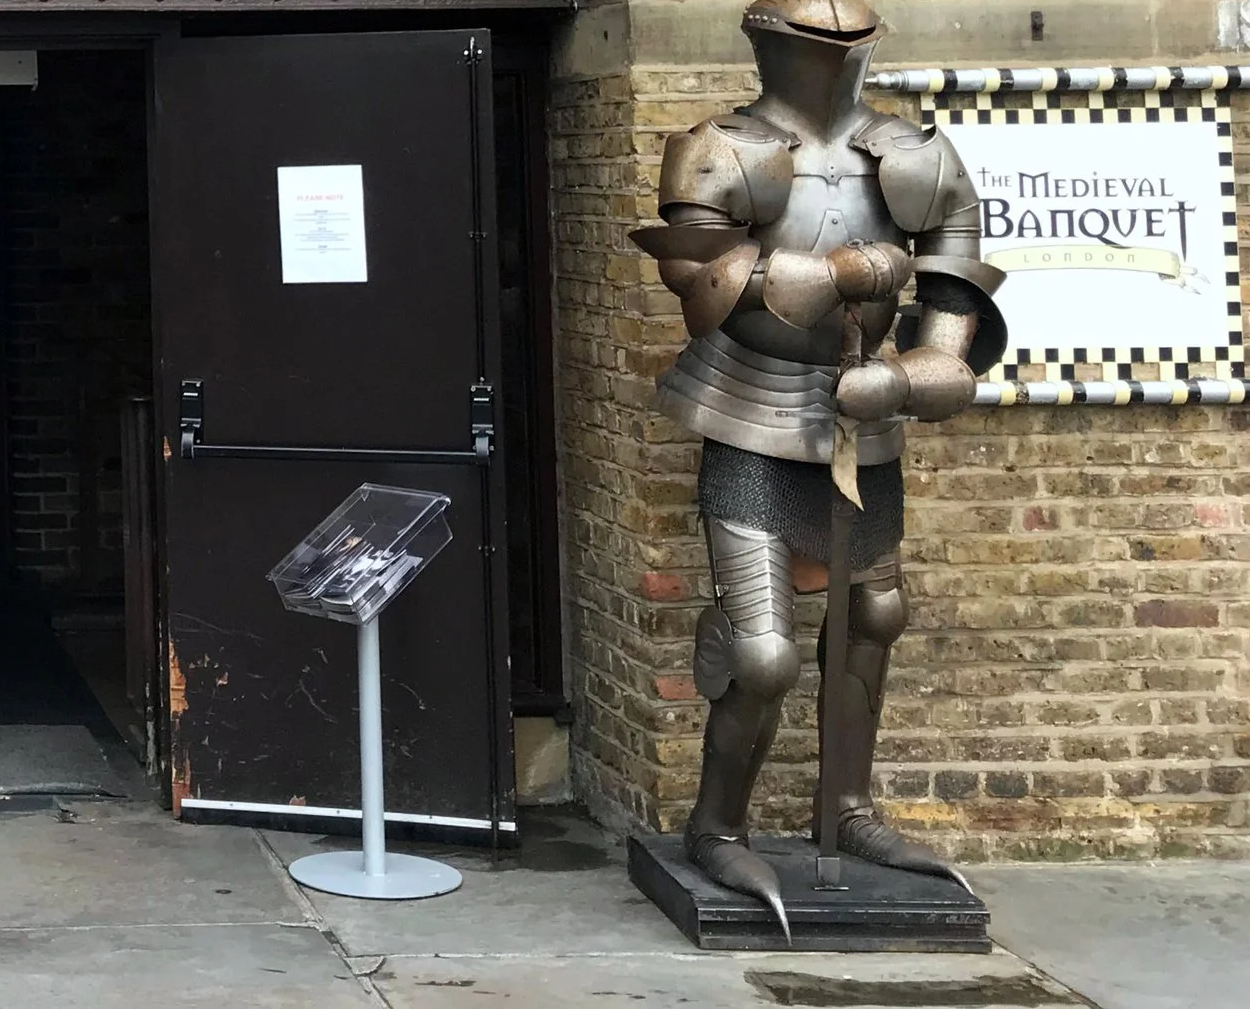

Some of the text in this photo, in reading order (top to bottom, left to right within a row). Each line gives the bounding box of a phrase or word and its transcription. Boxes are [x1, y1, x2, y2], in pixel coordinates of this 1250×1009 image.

[977, 167, 1174, 198] THE MEDIEVAL
[981, 198, 1196, 263] BANQUET
[1023, 252, 1135, 263] LONDON
